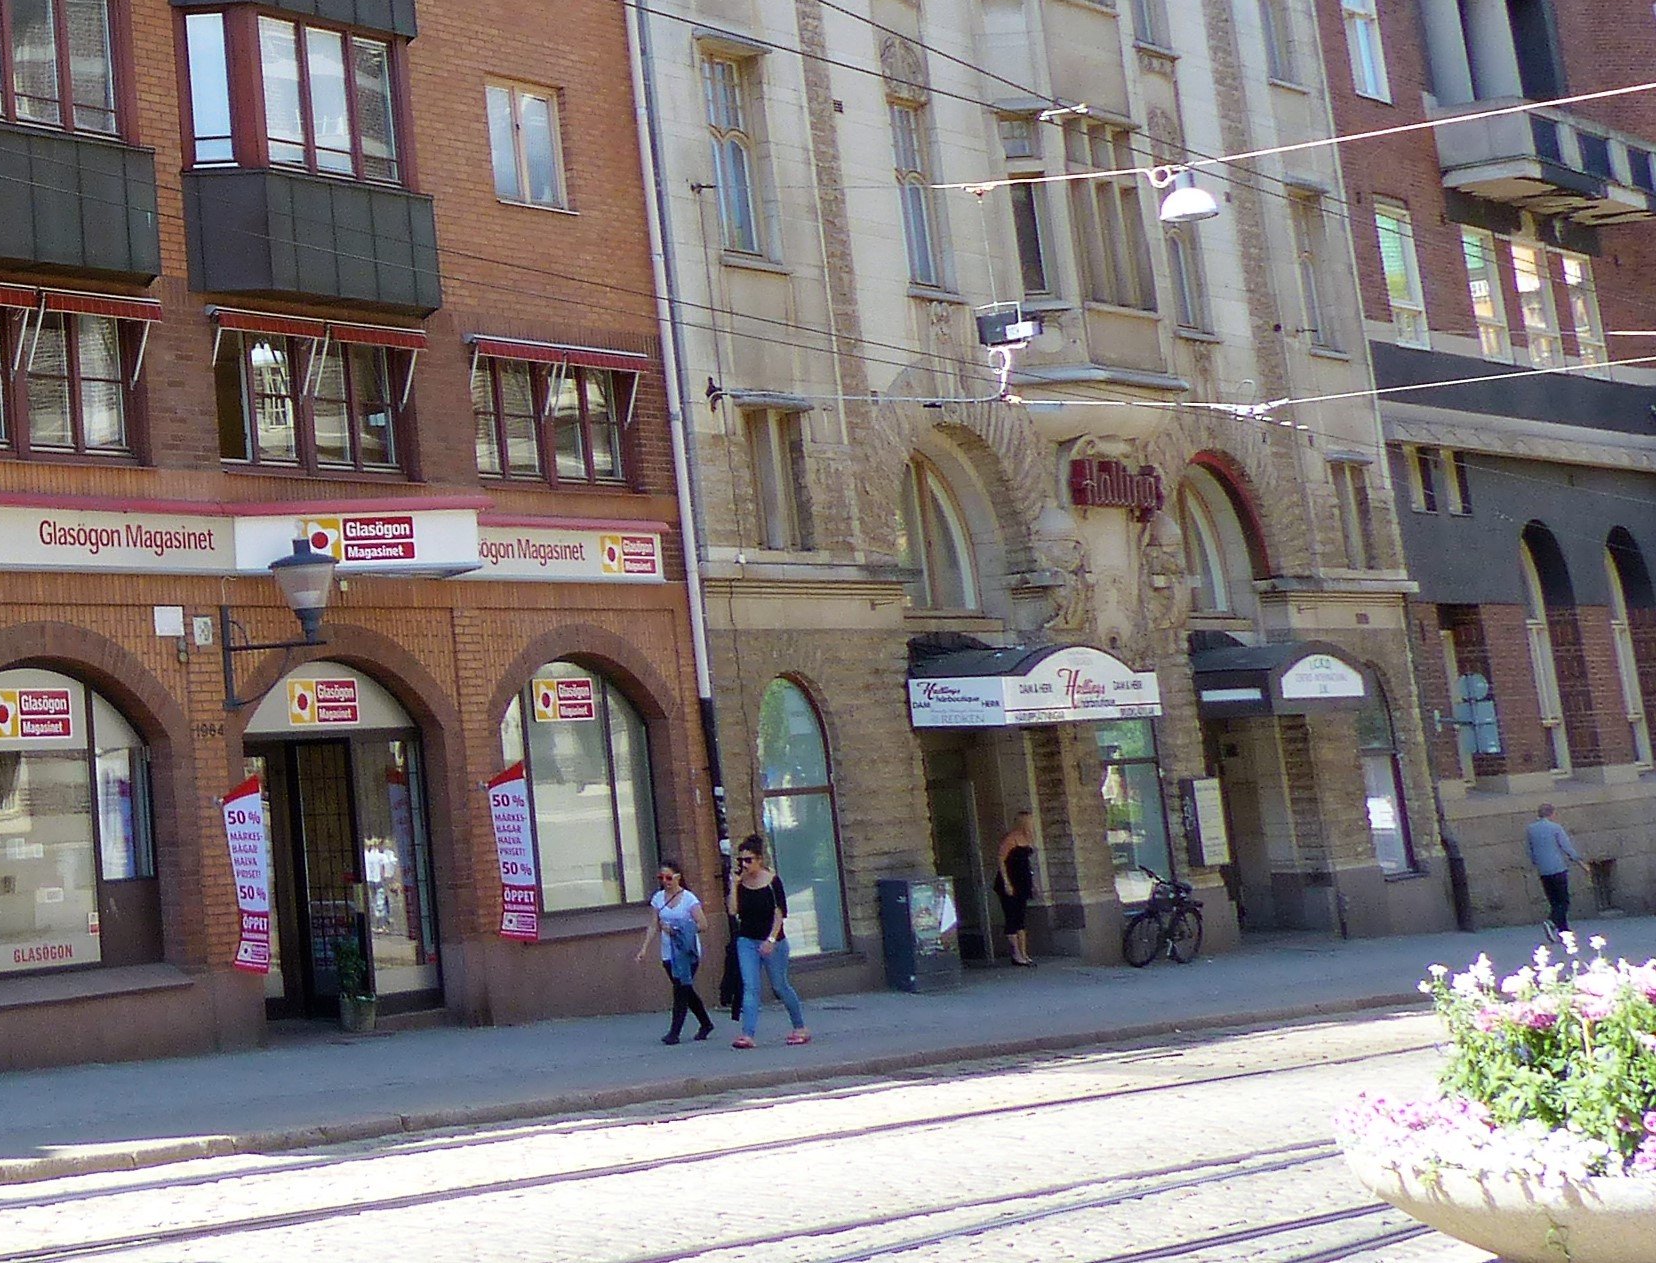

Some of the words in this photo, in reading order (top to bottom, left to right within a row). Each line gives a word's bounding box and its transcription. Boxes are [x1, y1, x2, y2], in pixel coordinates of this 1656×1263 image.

[39, 519, 121, 556] Glasögon
[126, 524, 215, 557] Magasinet
[345, 519, 411, 540] Glasögon
[346, 542, 404, 560] Magasinet
[478, 537, 514, 565] ögon
[516, 539, 586, 565] Magasinet
[316, 685, 355, 702] Glasögon
[557, 684, 591, 701] Glasögon
[21, 694, 67, 713] Glasögon
[912, 701, 931, 709] DAM
[317, 706, 352, 721] Magasinet
[21, 721, 63, 735] Magasinet
[493, 794, 510, 807] 50
[512, 794, 525, 807] %
[227, 810, 246, 825] 50
[248, 810, 261, 825] %
[502, 861, 518, 875] 50
[520, 863, 532, 876] %
[239, 885, 255, 900] 50
[256, 887, 266, 901] %
[504, 887, 535, 903] ÖPPET
[242, 913, 268, 931] ÖPPET
[13, 943, 73, 963] GLASÖGON
